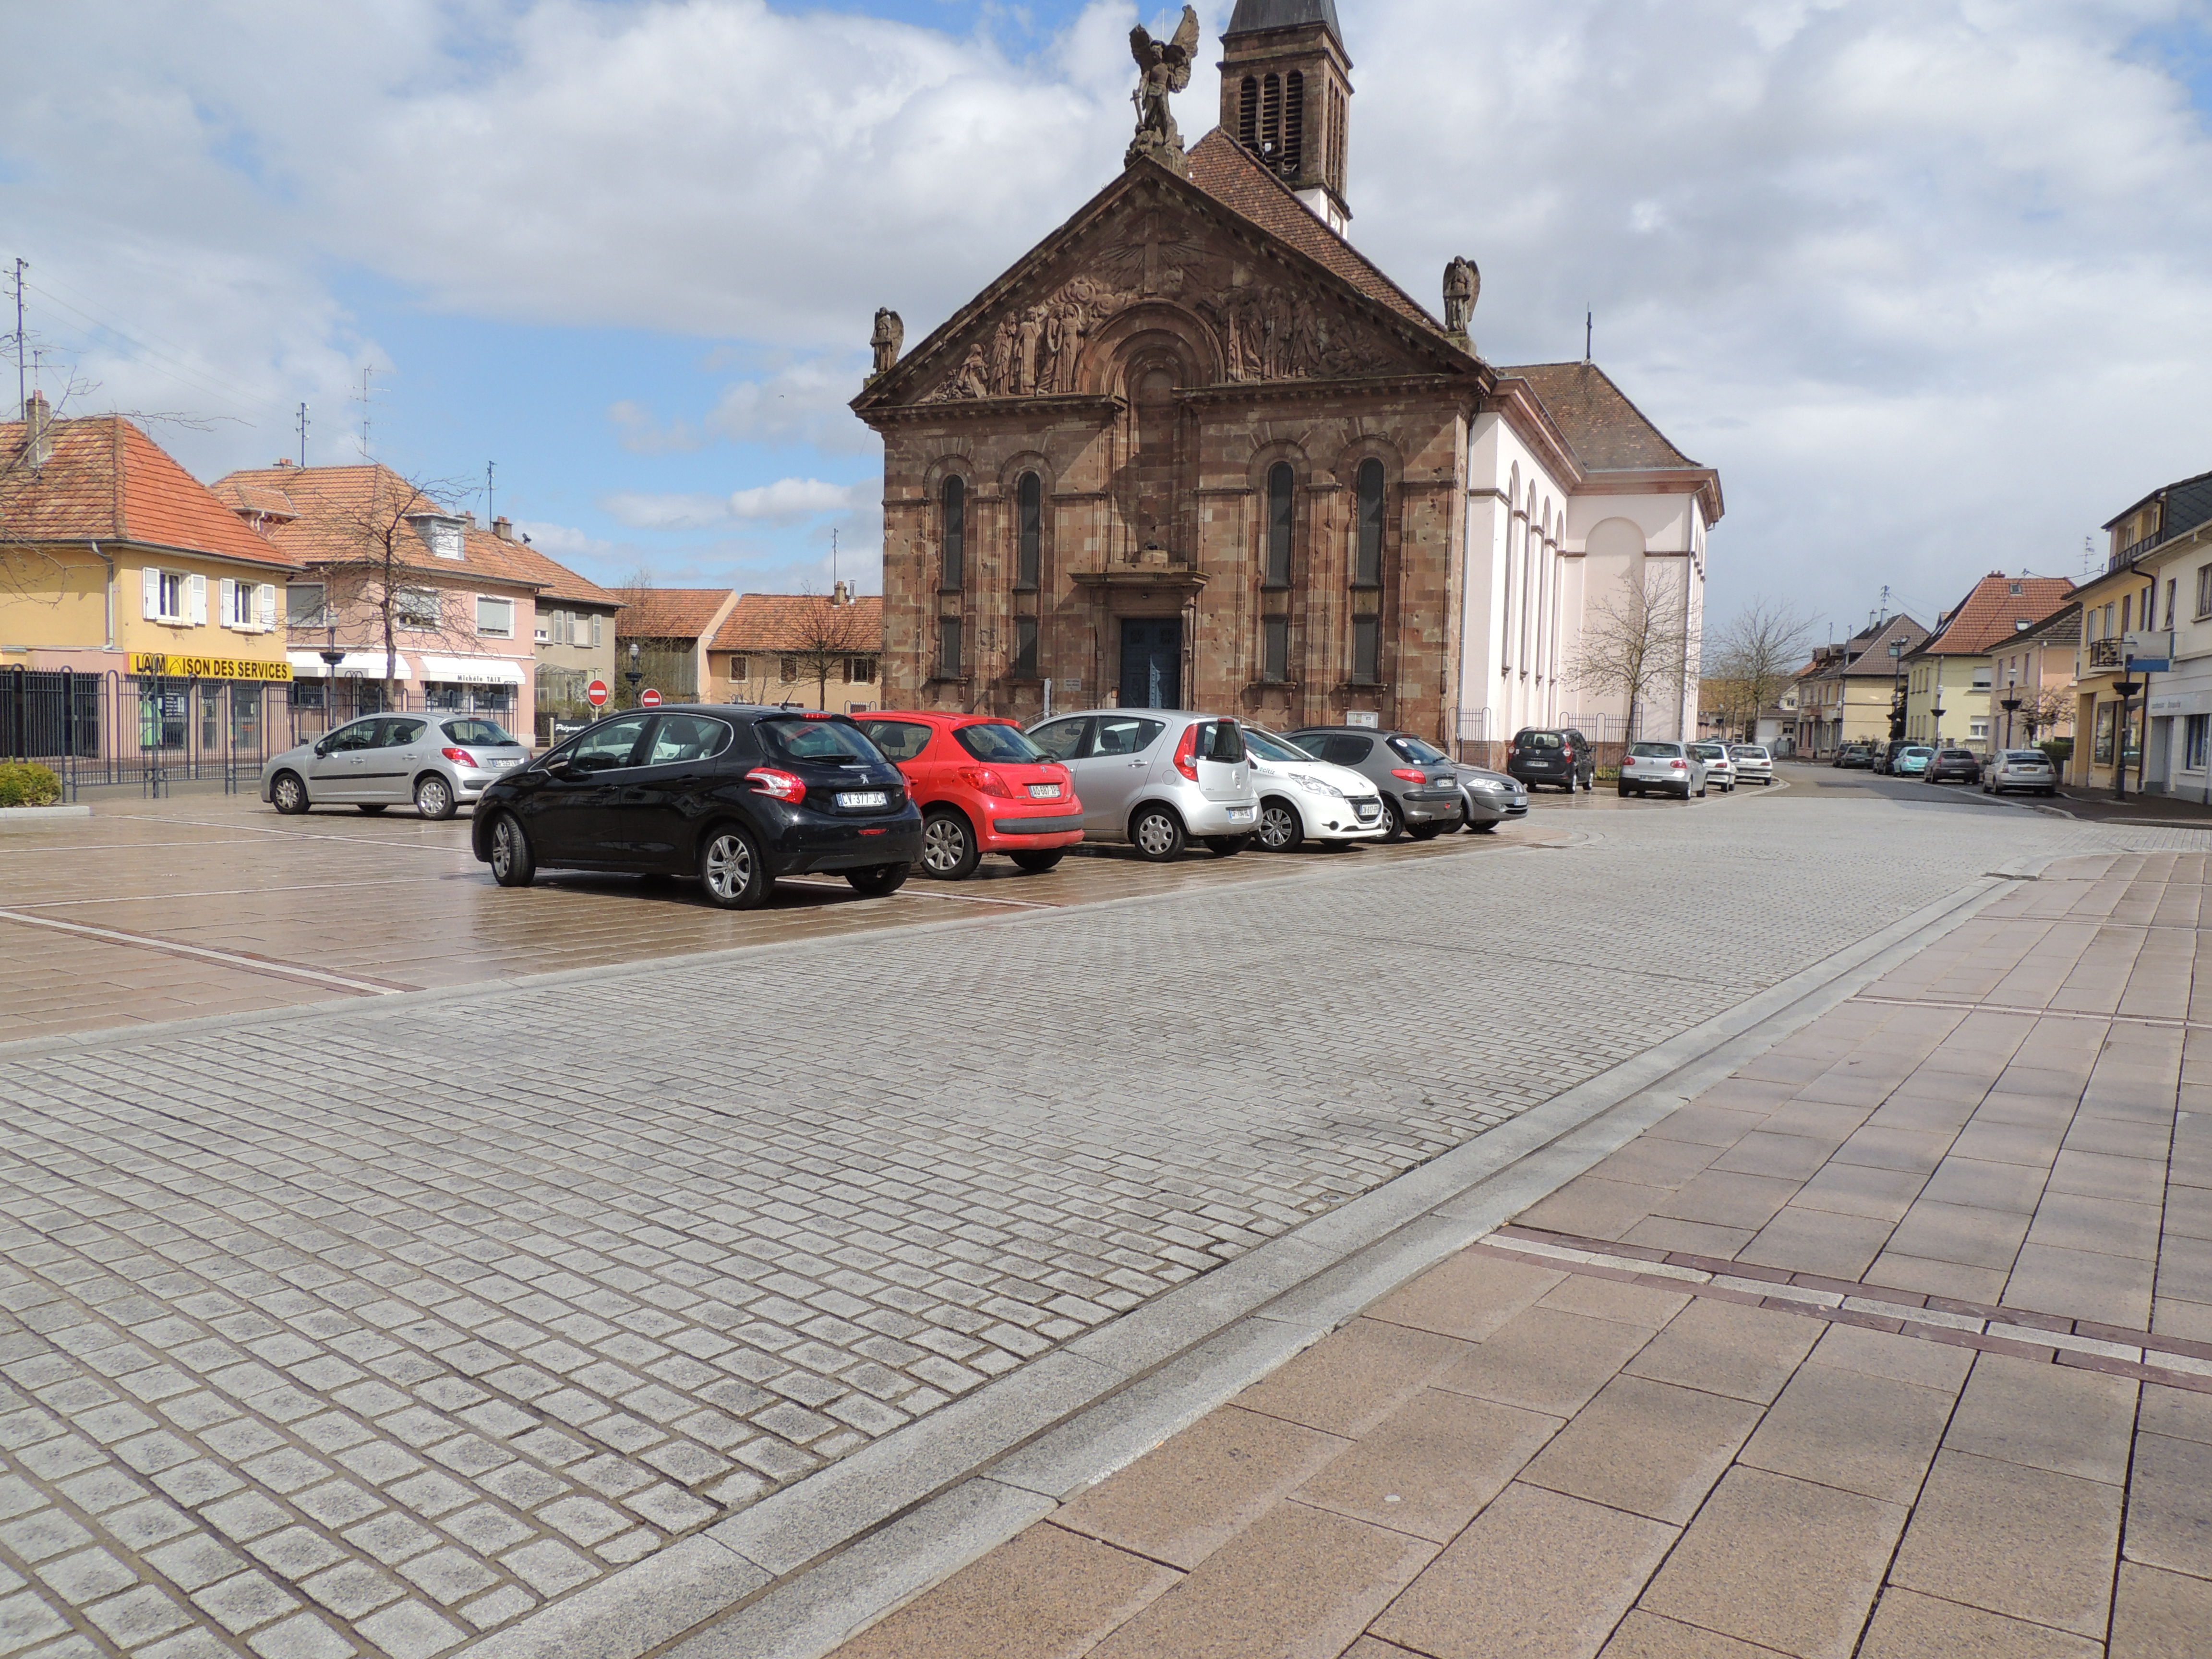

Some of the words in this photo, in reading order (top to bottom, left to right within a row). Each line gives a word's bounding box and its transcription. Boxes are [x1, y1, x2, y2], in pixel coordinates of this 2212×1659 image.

[136, 655, 153, 672] LA
[156, 656, 210, 675] MAISON
[214, 660, 234, 676] DES
[238, 661, 287, 679] SERVICES
